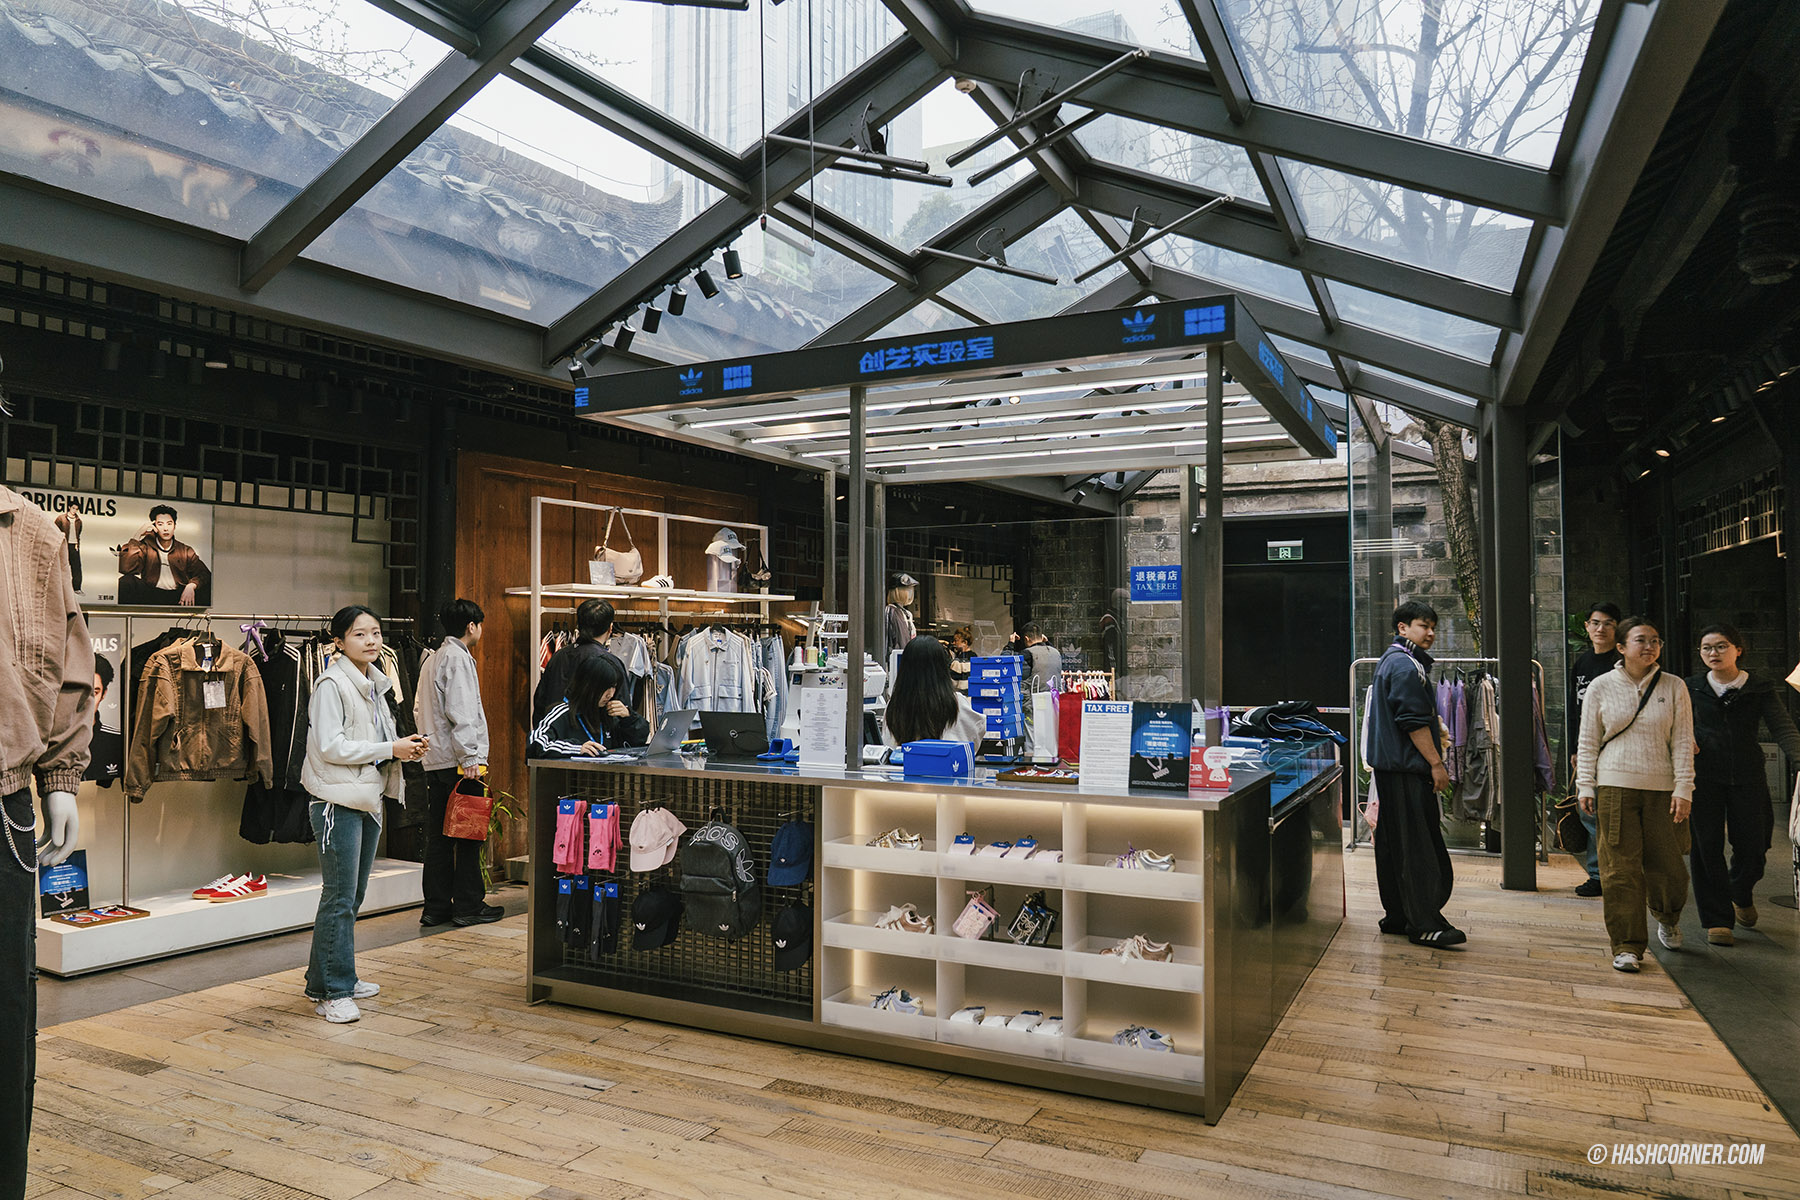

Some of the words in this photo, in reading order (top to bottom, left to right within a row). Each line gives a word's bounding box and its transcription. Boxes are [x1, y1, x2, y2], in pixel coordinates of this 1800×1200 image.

[1122, 334, 1155, 343] adidas
[859, 336, 994, 374] 创艺实验室
[679, 388, 703, 396] adidas
[1135, 570, 1178, 581] 退税商店
[1156, 582, 1178, 590] FREE
[1086, 704, 1103, 712] TAX
[1105, 704, 1128, 713] FREE
